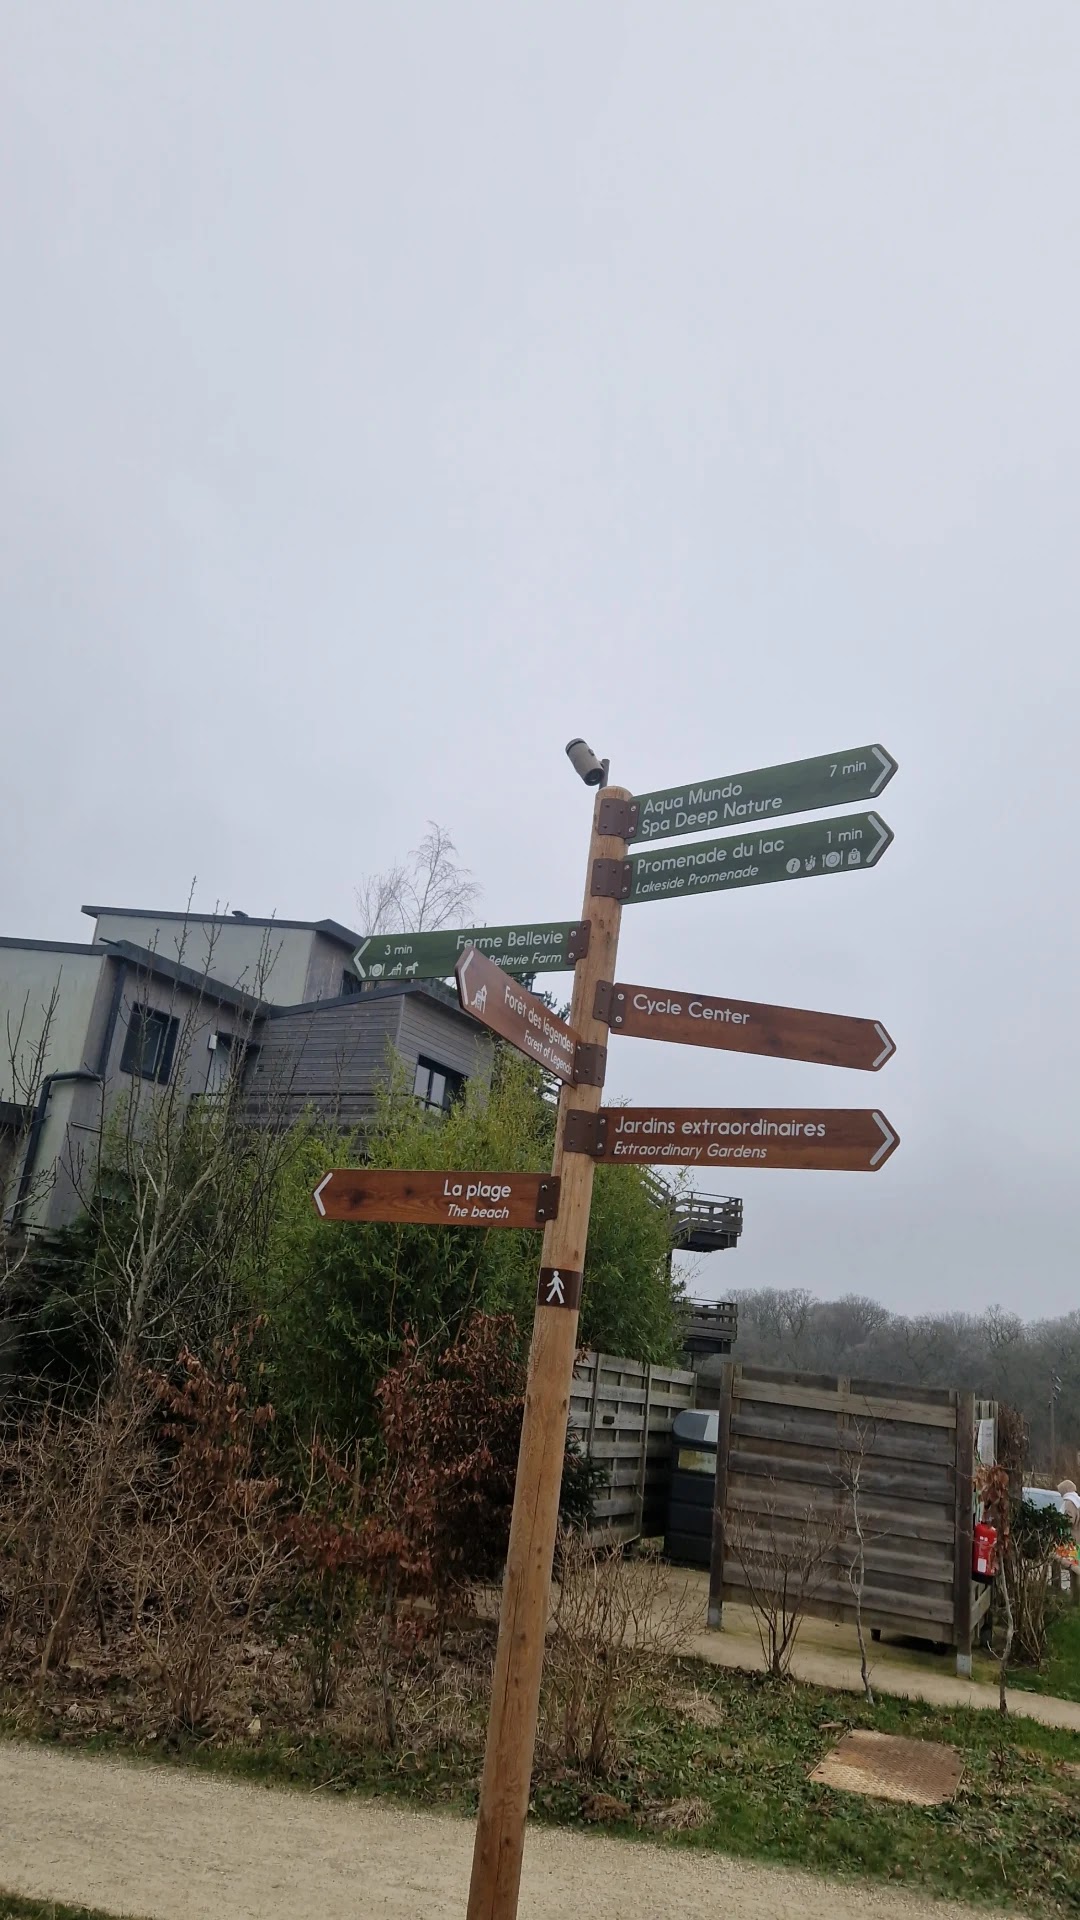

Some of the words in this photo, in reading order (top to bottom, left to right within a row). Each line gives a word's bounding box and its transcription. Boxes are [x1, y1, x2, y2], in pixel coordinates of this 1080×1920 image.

[829, 765, 837, 777] 7
[842, 761, 867, 774] min
[643, 795, 683, 816] Aqua
[688, 782, 743, 805] Mundo
[641, 818, 670, 836] Spa
[674, 811, 718, 829] Deep
[723, 797, 783, 818] Nature
[826, 831, 832, 843] 1
[838, 828, 863, 842] min
[636, 850, 728, 875] Promenade
[732, 843, 754, 858] du
[758, 839, 785, 854] lac
[635, 877, 684, 895] Lakeside
[687, 865, 759, 885] Promenade
[384, 945, 391, 955] 3
[394, 944, 413, 955] min
[456, 935, 503, 950] Ferme
[507, 930, 564, 947] Bellevie
[531, 952, 562, 964] Farm
[633, 994, 682, 1015] Cycle
[688, 1002, 750, 1025] Center
[528, 1007, 542, 1030] des
[543, 1016, 574, 1055] légendes
[524, 1029, 543, 1053] Forest
[543, 1047, 551, 1059] of
[550, 1050, 572, 1075] Legends
[615, 1116, 676, 1134] Jardins
[681, 1118, 826, 1137] extraordinaires
[613, 1141, 702, 1159] Extraordinary
[707, 1143, 767, 1159] Gardens
[443, 1179, 462, 1196] La
[466, 1181, 511, 1202] plage
[447, 1204, 468, 1217] The
[472, 1206, 509, 1219] beach
